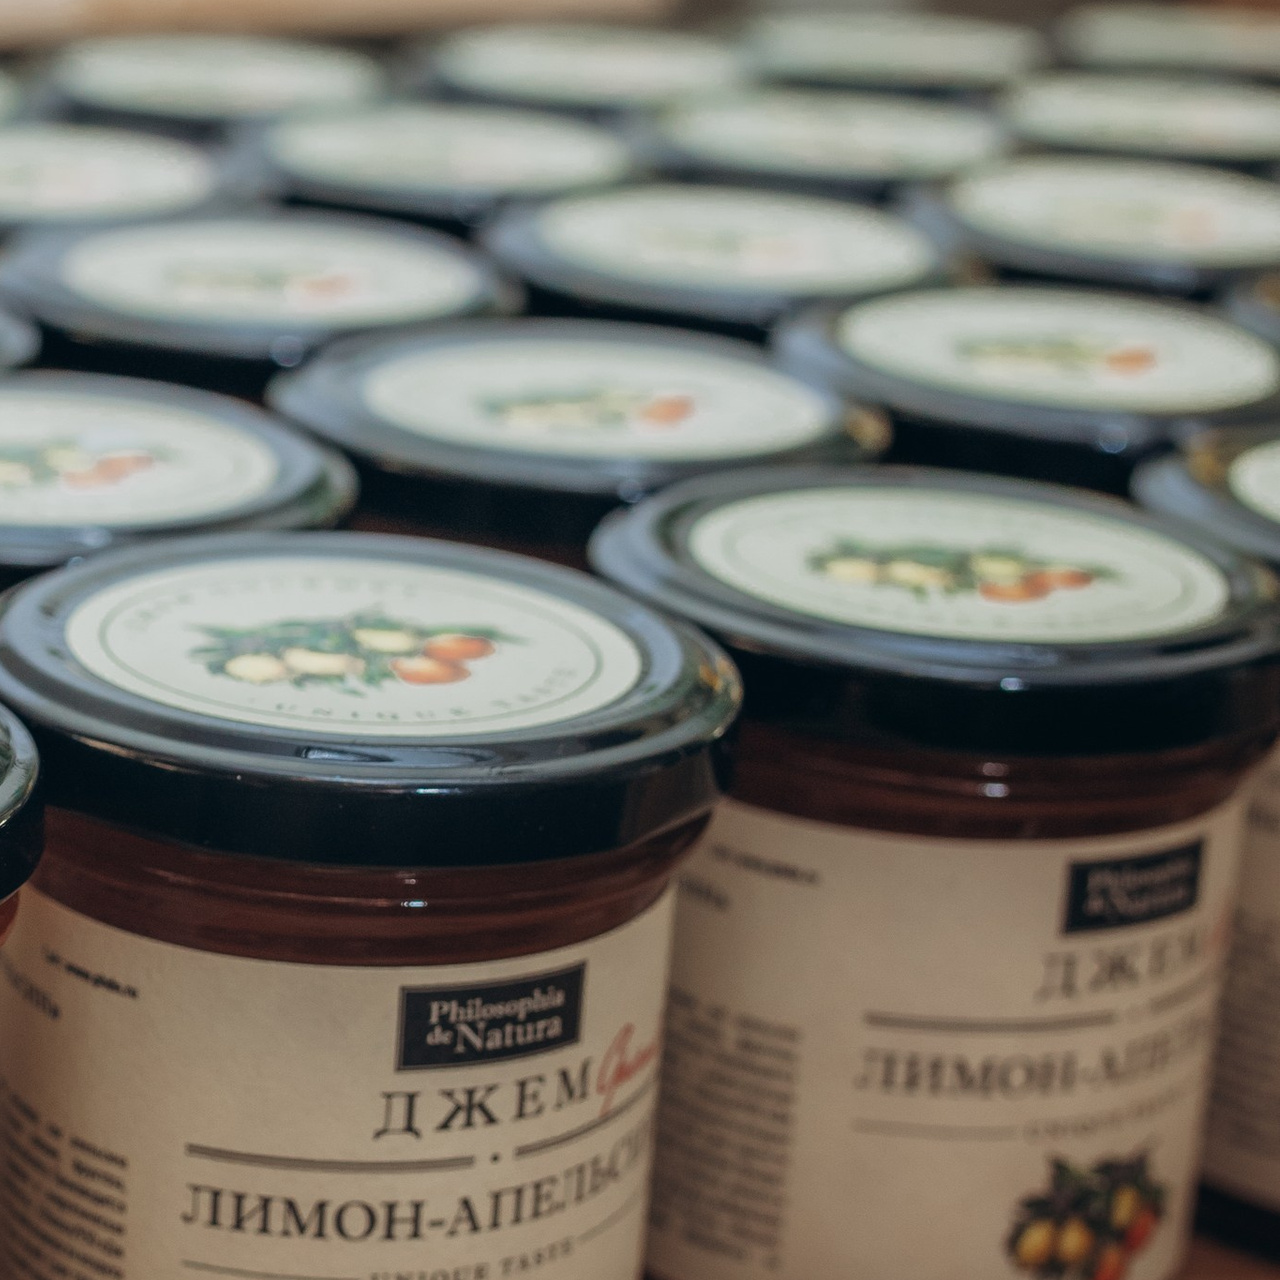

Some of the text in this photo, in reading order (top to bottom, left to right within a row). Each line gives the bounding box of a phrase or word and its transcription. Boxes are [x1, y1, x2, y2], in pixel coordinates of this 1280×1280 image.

[429, 985, 566, 1025] Philosophia
[426, 1016, 564, 1054] de Natura
[372, 1056, 594, 1140] ДЖЕМ
